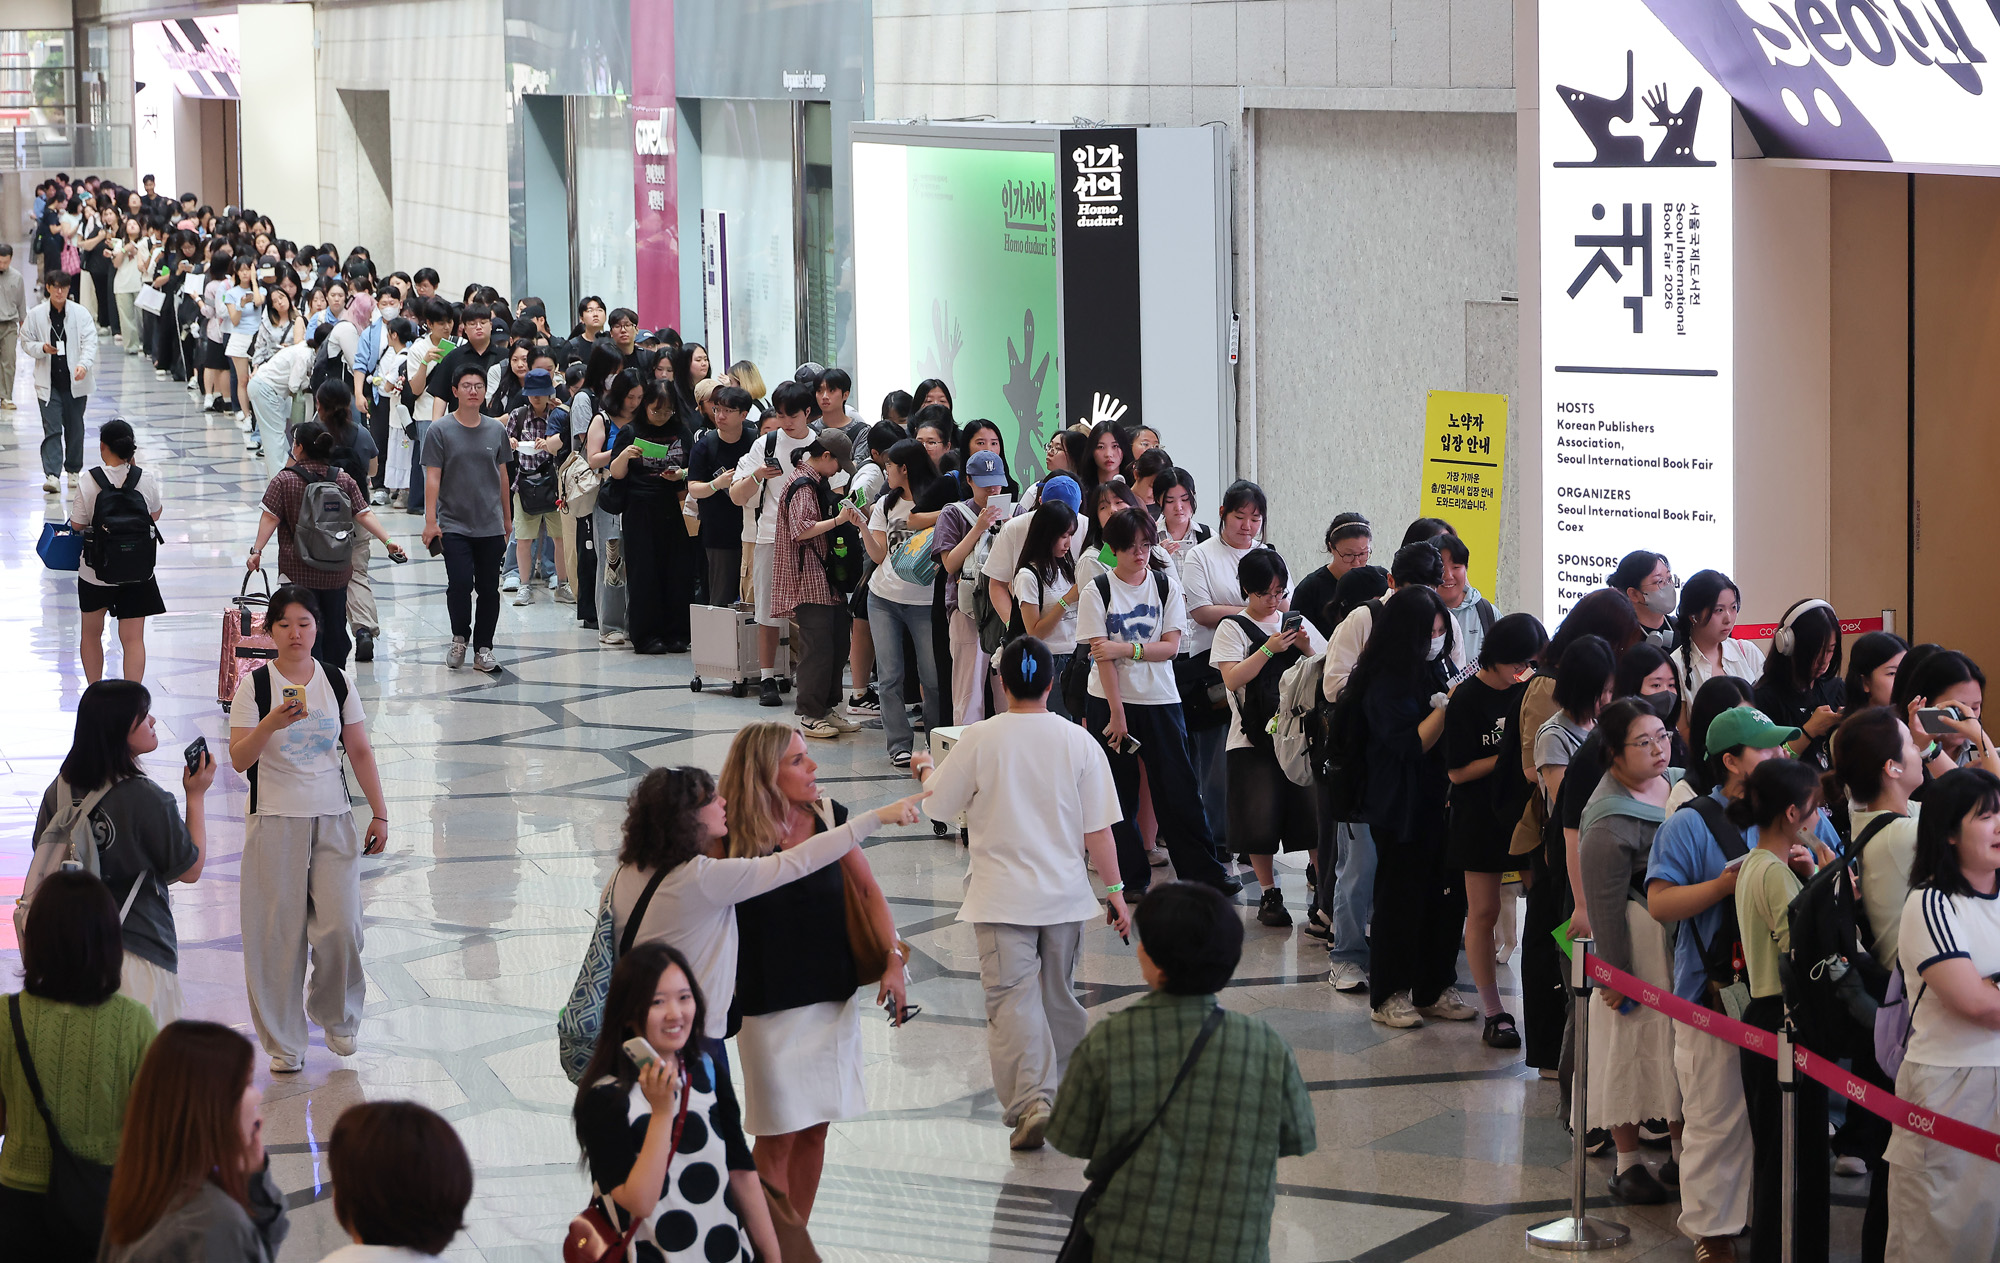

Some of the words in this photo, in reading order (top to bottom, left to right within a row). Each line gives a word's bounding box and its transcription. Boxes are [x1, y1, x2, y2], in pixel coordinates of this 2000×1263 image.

[1077, 203, 1118, 215] Homo
[1077, 214, 1123, 227] duduri
[1664, 203, 1673, 239] Book
[1676, 203, 1686, 243] Seoul
[1004, 233, 1024, 253] Homo
[1024, 235, 1047, 255] duduri
[1664, 243, 1673, 270] Fair
[1689, 202, 1701, 305] 서울국제도서전
[1566, 203, 1653, 333] 책
[1664, 274, 1674, 310] 2026
[1676, 247, 1686, 335] International
[1557, 402, 1595, 414] HOSTS
[1448, 412, 1485, 432] 노약자
[1557, 419, 1596, 431] Korean
[1598, 420, 1655, 434] Publishers
[1440, 433, 1464, 453] 입장
[1467, 435, 1491, 455] 안내
[1557, 436, 1625, 451] Association,
[1557, 453, 1586, 465] Seoul
[1588, 454, 1661, 468] International
[1663, 457, 1690, 470] Book
[1692, 458, 1714, 470] Fair
[1446, 471, 1460, 482] 가장
[1460, 472, 1480, 484] 가까운
[1431, 482, 1465, 496] 출/입구에서
[1466, 486, 1480, 497] 입장
[1480, 487, 1494, 499] 안내
[1557, 487, 1631, 501] ORGANIZERS
[1436, 496, 1488, 512] 도와드리겠습니다.
[1557, 503, 1586, 516] Seoul
[1588, 505, 1661, 519] International
[1663, 508, 1690, 521] Book
[1692, 510, 1716, 524] Fair,
[1557, 520, 1585, 533] Coex
[1557, 554, 1618, 569] SPONSORS
[1558, 571, 1602, 586] Changbi
[1759, 626, 1777, 636] coe
[1841, 620, 1862, 632] oex
[1595, 964, 1612, 983] coex
[1642, 989, 1661, 1007] coex
[1692, 1010, 1710, 1028] coex
[1745, 1031, 1765, 1049] coex
[1794, 1050, 1808, 1070] oex
[1846, 1080, 1867, 1102] coex
[1908, 1111, 1935, 1135] coex
